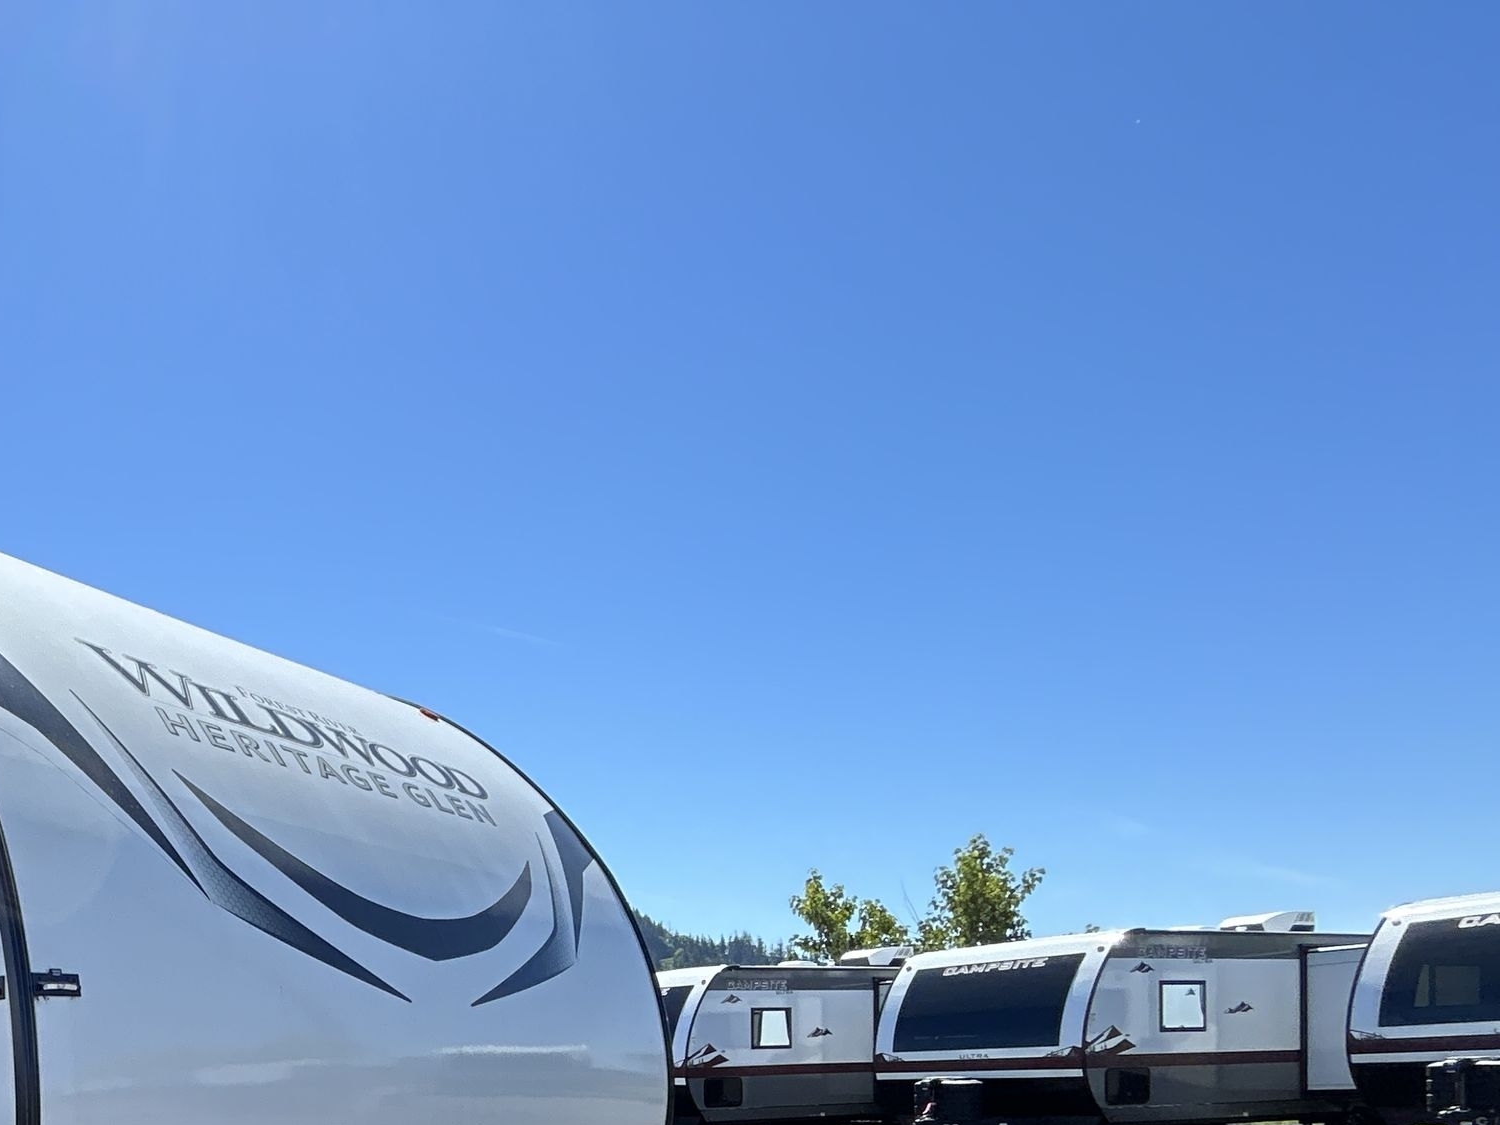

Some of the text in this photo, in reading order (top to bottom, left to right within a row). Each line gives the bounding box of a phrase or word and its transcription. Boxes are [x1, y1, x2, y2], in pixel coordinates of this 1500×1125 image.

[74, 637, 489, 800] WILDWOOD
[154, 705, 498, 828] HERITAGE GLEN
